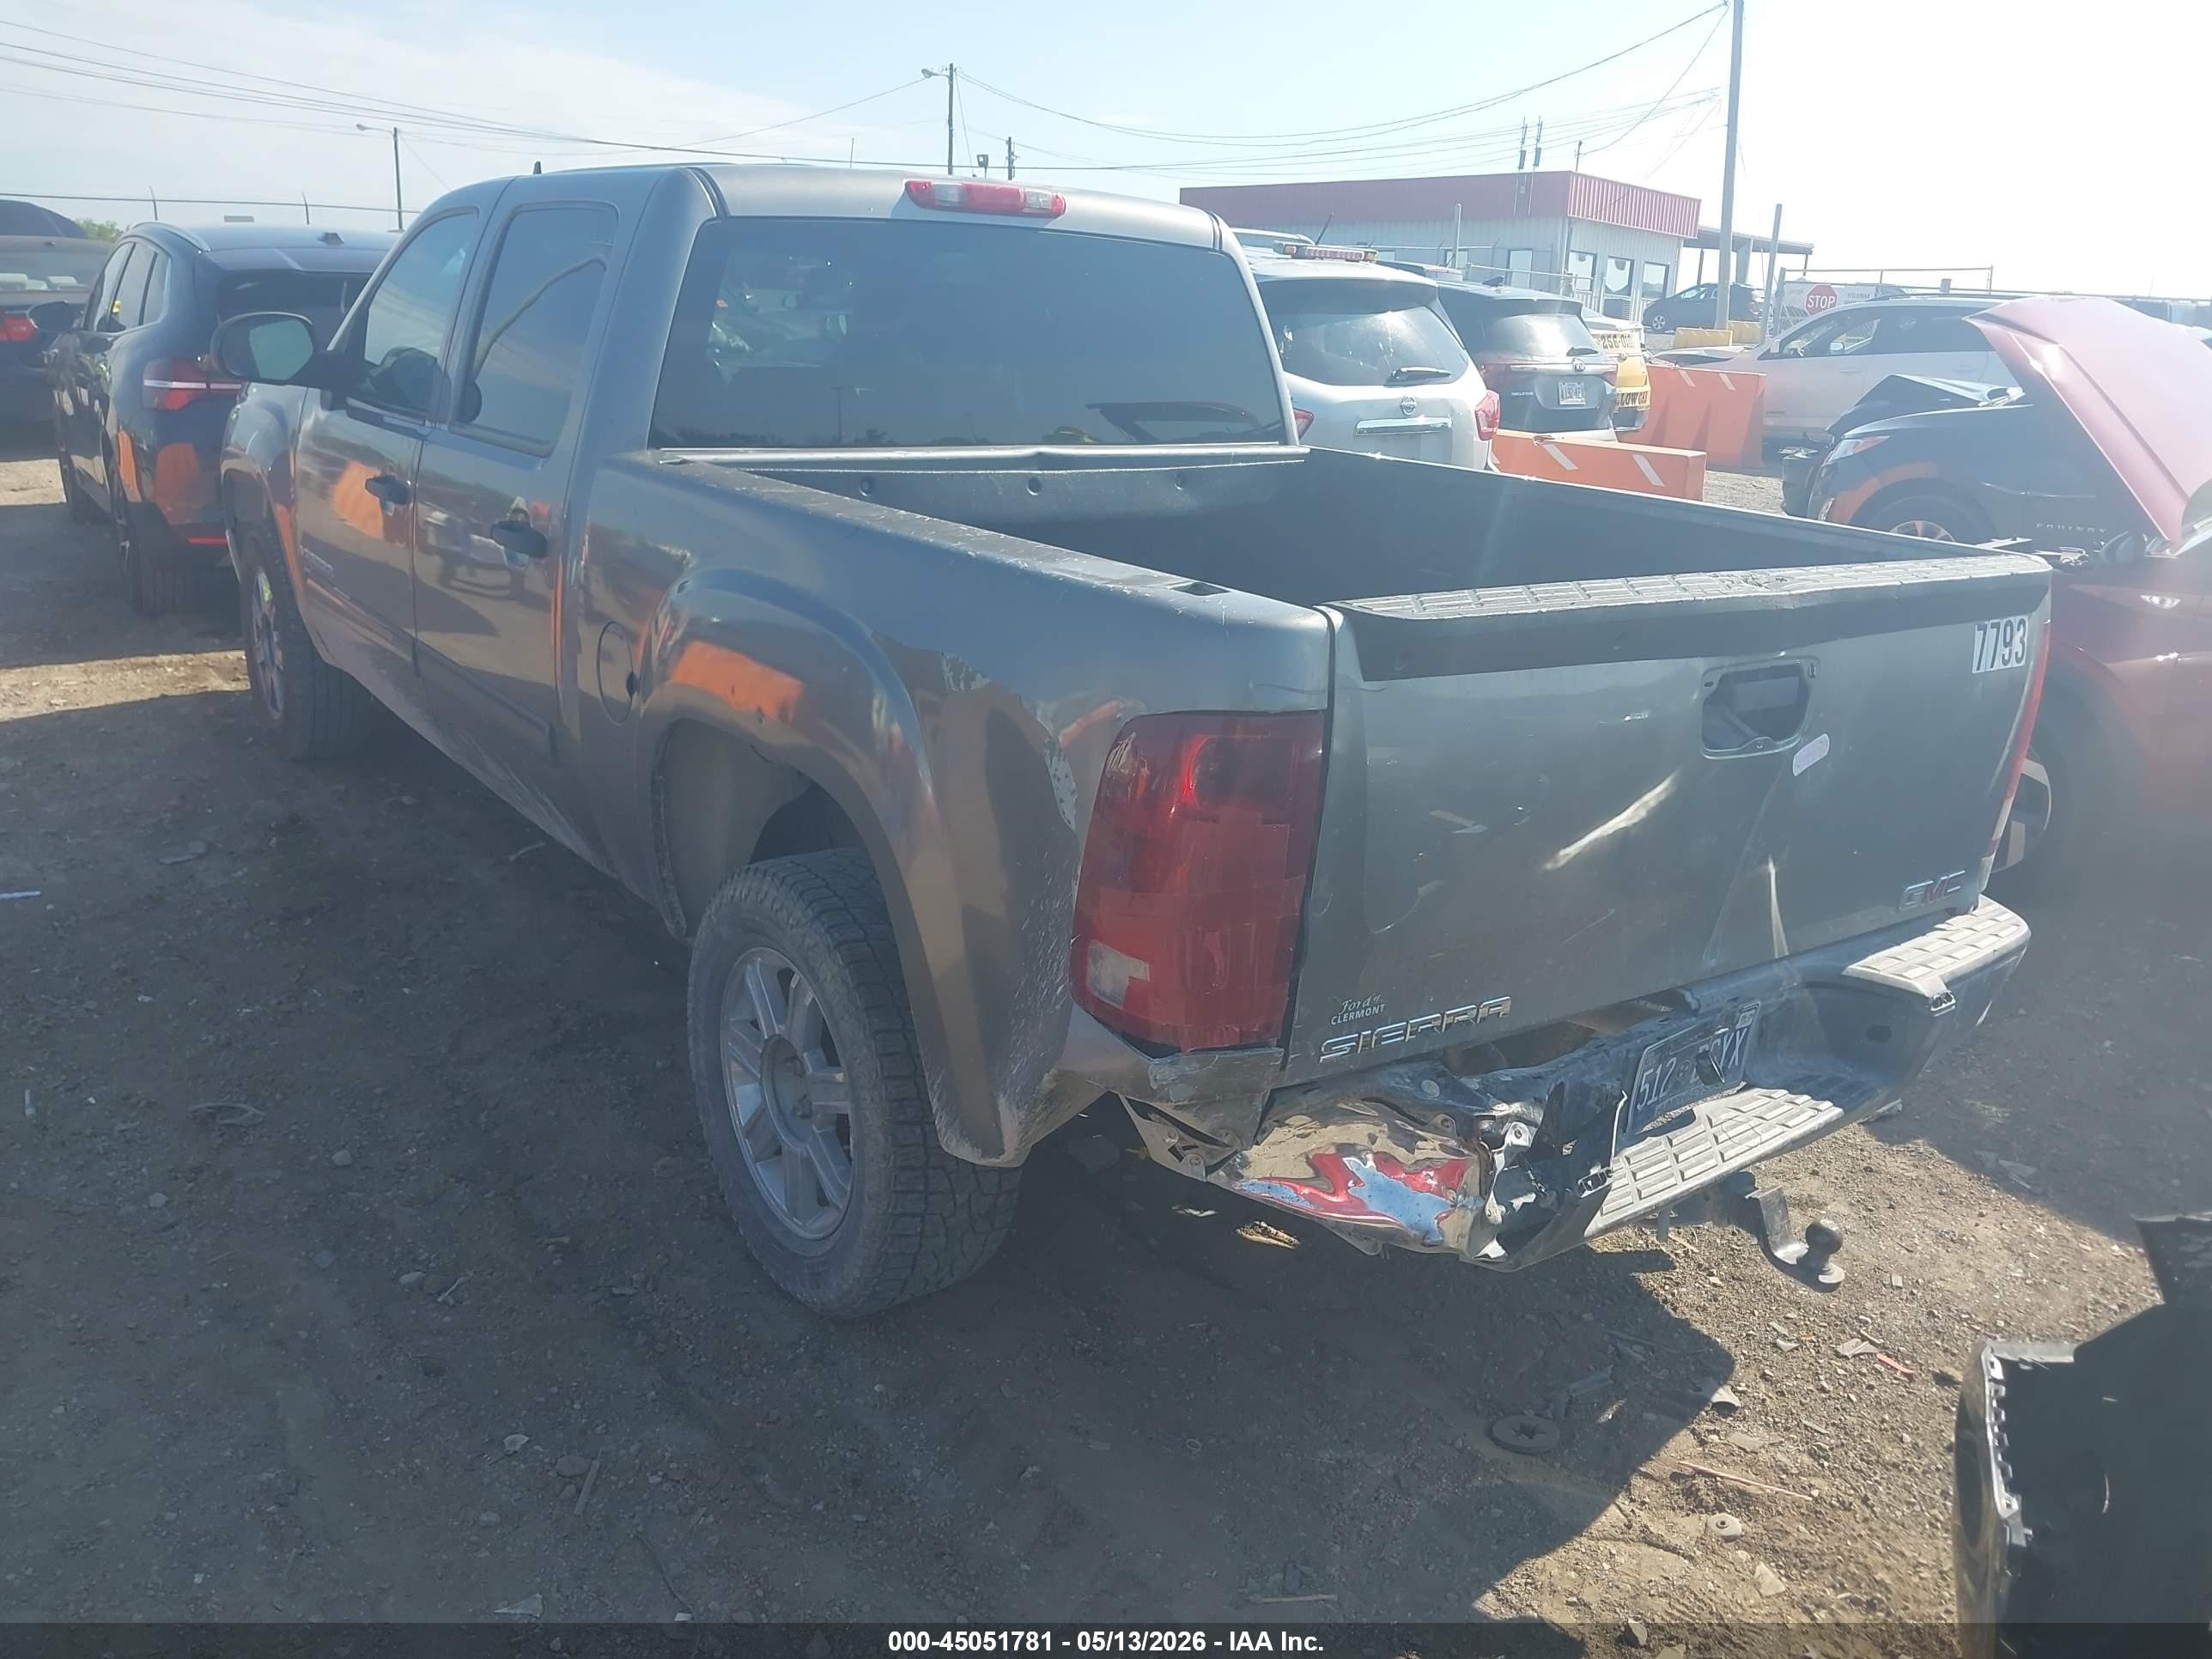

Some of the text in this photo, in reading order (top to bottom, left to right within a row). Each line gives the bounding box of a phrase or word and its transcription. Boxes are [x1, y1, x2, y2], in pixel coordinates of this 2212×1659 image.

[1808, 295, 1836, 309] STOP
[1977, 617, 2027, 672] 7793
[1898, 870, 1966, 911] GMC
[1331, 1004, 1386, 1025] CLERMONT
[1339, 996, 1372, 1015] Ford
[1319, 996, 1511, 1063] SIERRA
[1636, 1057, 1677, 1111] 512
